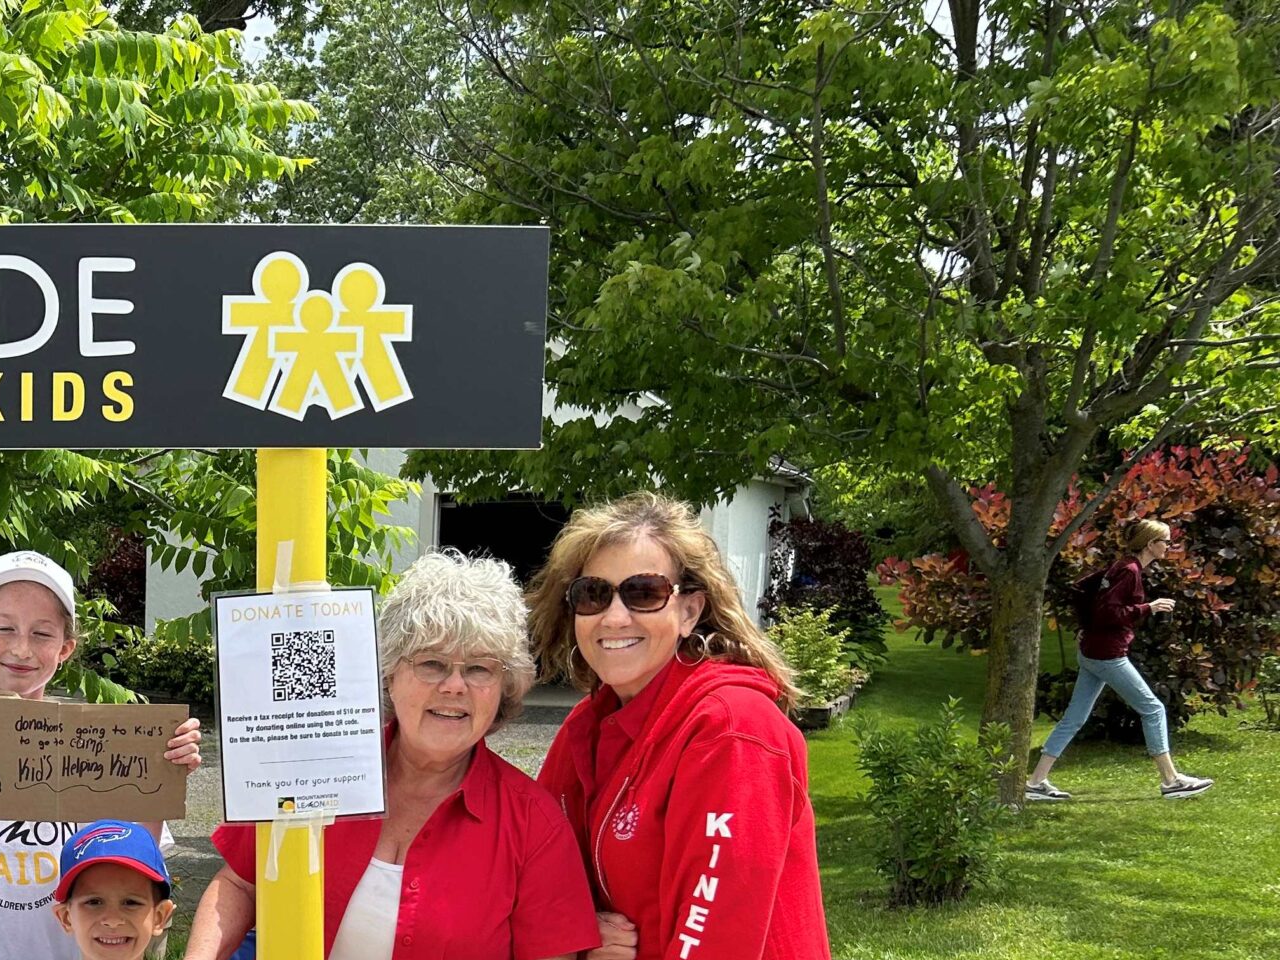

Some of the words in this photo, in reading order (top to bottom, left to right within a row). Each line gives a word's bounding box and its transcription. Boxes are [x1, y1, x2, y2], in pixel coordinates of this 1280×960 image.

[231, 604, 303, 622] DONATE
[311, 602, 363, 617] TODAY!
[272, 712, 294, 721] receipt
[306, 710, 335, 718] donations
[76, 725, 106, 740] going
[112, 725, 126, 736] to
[246, 725, 254, 733] by
[255, 724, 285, 732] donating
[335, 719, 343, 727] QR
[19, 736, 30, 746] to
[38, 739, 51, 751] go
[53, 737, 64, 747] to
[267, 734, 289, 742] please
[322, 730, 342, 738] donate
[62, 755, 104, 781] Helping
[245, 780, 272, 789] Thank
[275, 780, 292, 790] you
[295, 778, 309, 786] for
[312, 777, 331, 787] your
[333, 774, 367, 784] support!
